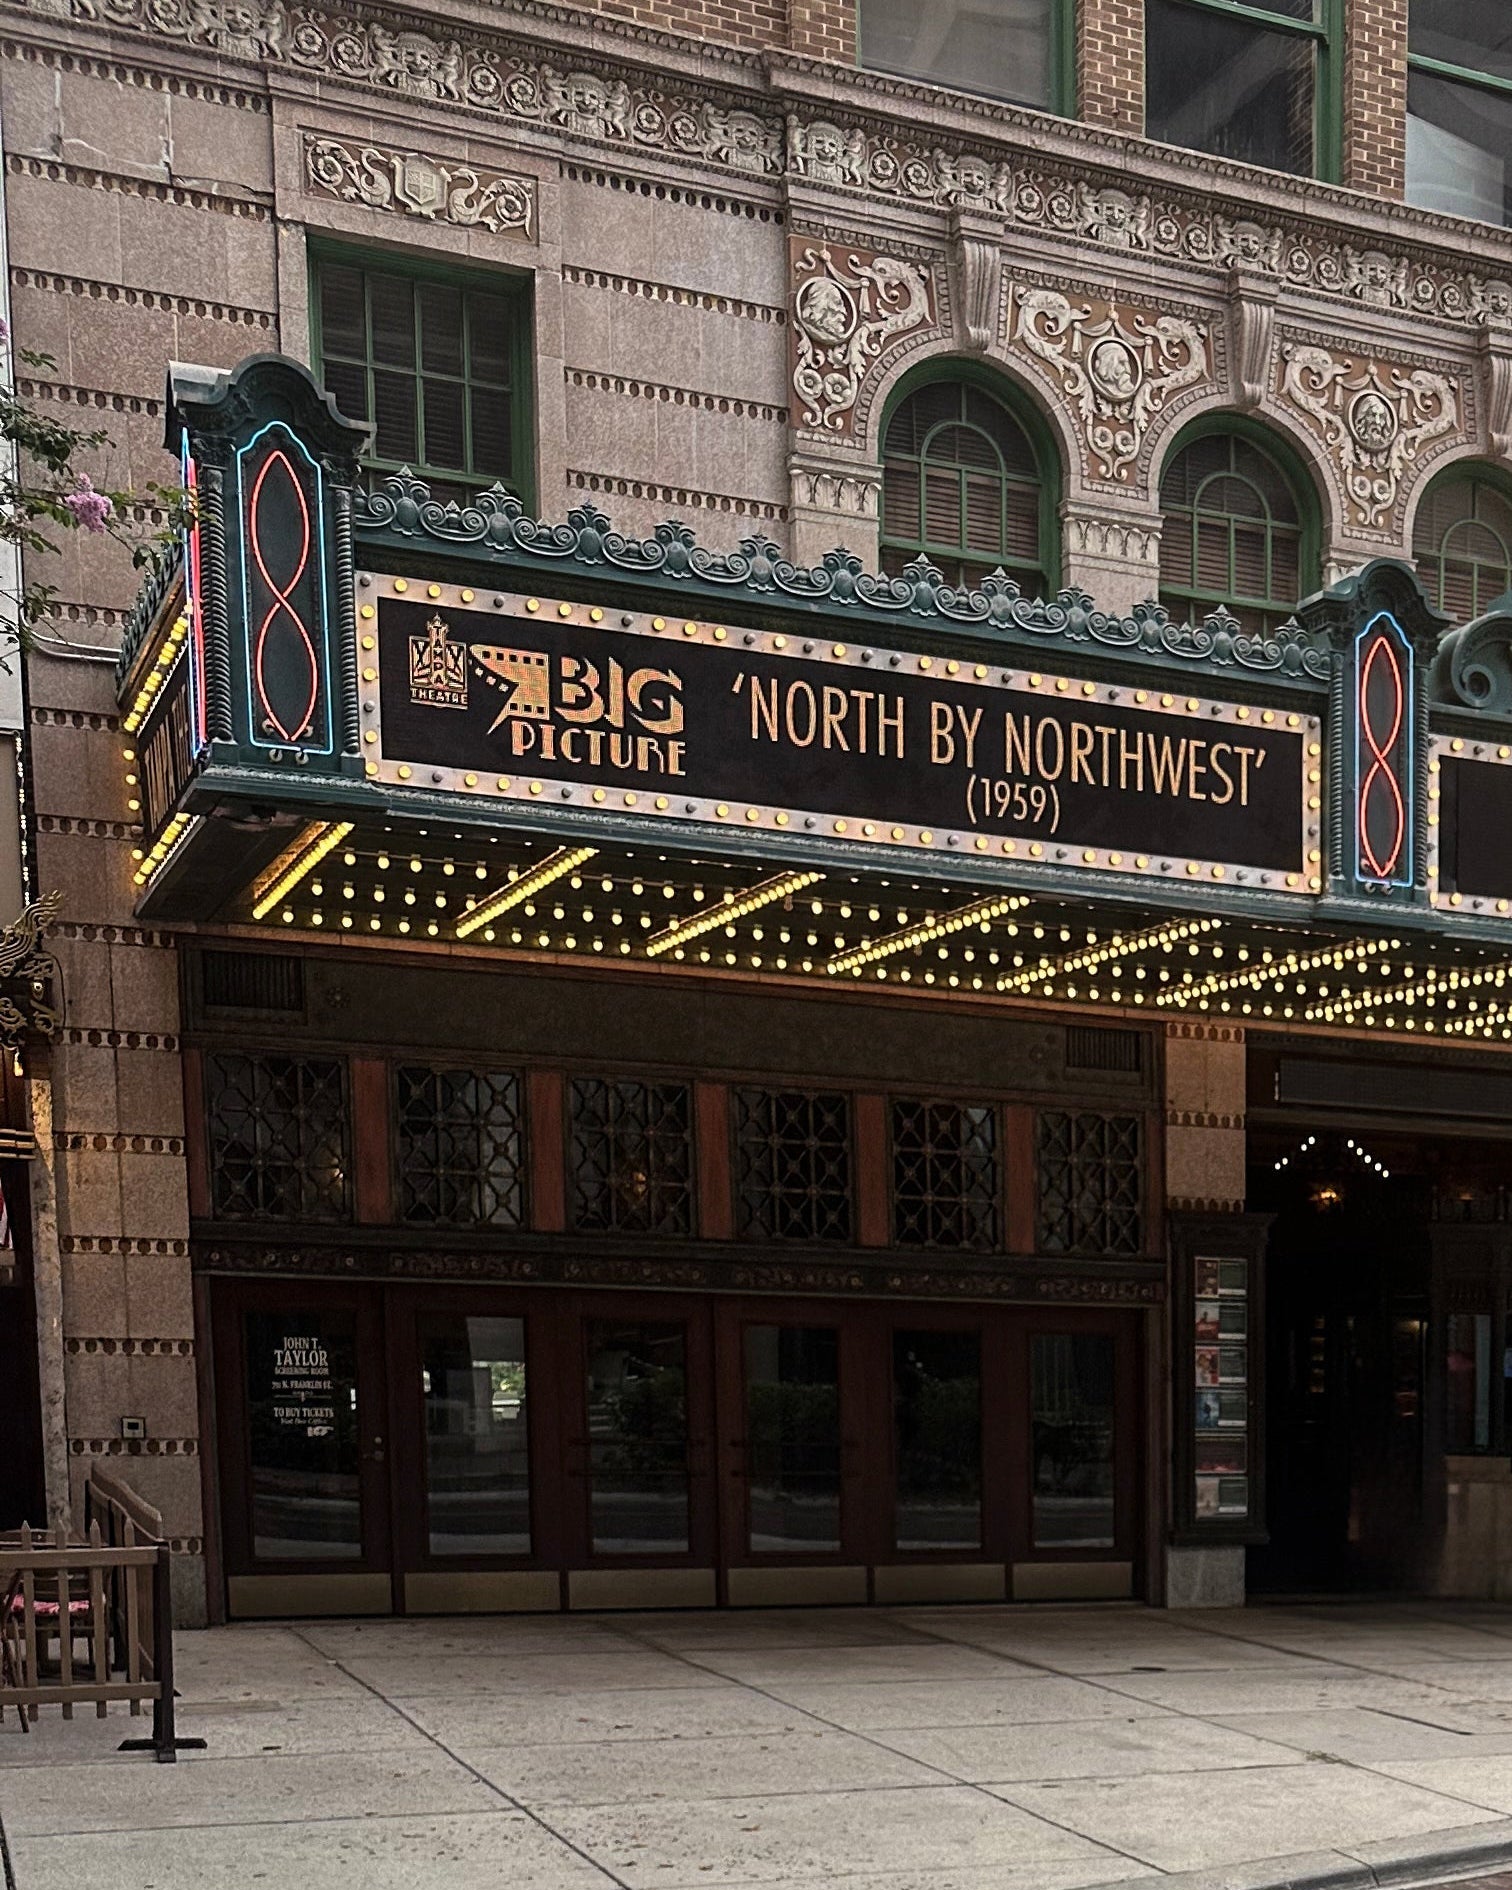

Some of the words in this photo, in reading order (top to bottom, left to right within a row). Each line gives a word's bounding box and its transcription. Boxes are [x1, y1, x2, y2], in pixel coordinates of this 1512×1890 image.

[432, 625, 444, 684] TAMPA
[410, 688, 468, 705] THEATRE
[551, 655, 684, 734] BIG
[510, 719, 687, 777] PICTURE
[731, 671, 905, 761] 'NORTH
[927, 702, 988, 767] BY
[1002, 714, 1268, 808] NORTHWEST'
[966, 776, 1061, 835] (1959)
[273, 1350, 329, 1367] TAYLOR
[283, 1336, 310, 1351] JOHN
[311, 1337, 322, 1350] T.
[273, 1407, 285, 1418] TO
[285, 1407, 301, 1418] BUY
[301, 1407, 335, 1418] TICKETS
